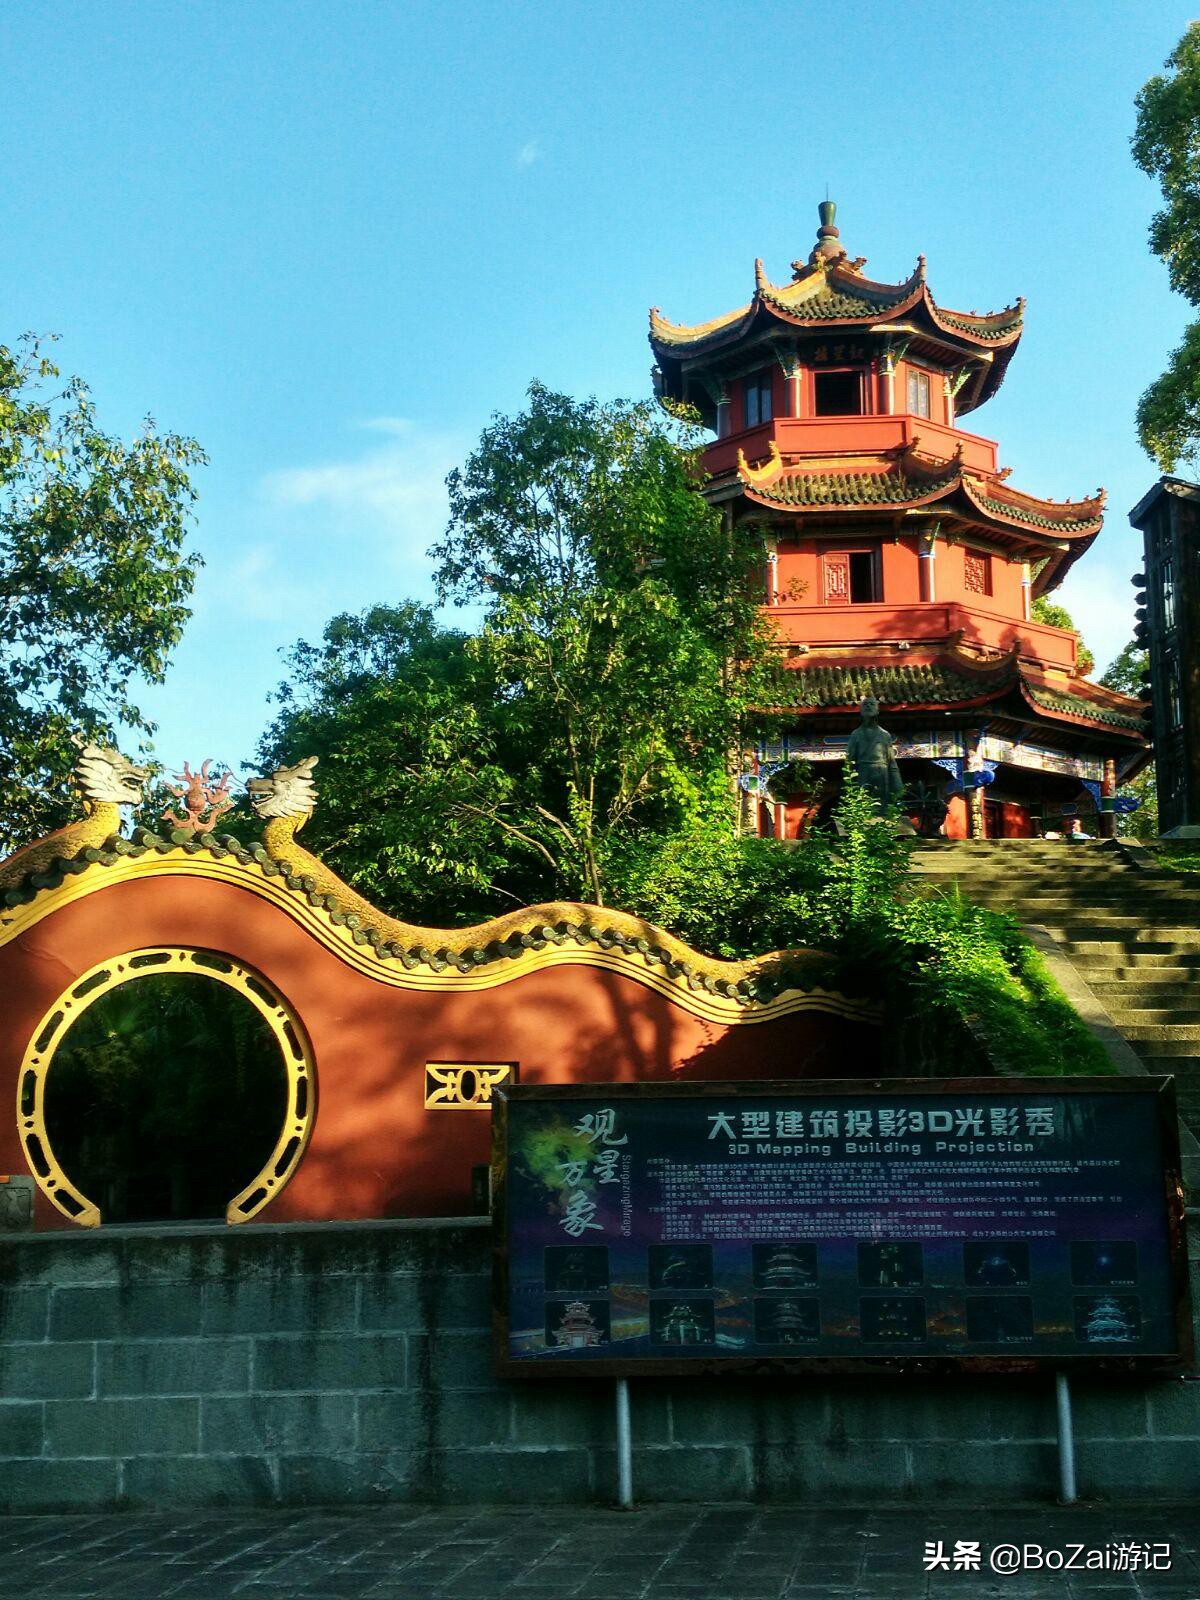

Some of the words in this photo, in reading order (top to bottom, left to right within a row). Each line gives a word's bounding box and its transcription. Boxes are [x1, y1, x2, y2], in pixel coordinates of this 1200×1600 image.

[707, 1107, 1055, 1140] 大型建筑投影3D光影秀
[728, 1143, 749, 1155] 3D
[756, 1143, 831, 1157] Mapping
[845, 1141, 922, 1156] Building
[935, 1140, 1034, 1156] Projection
